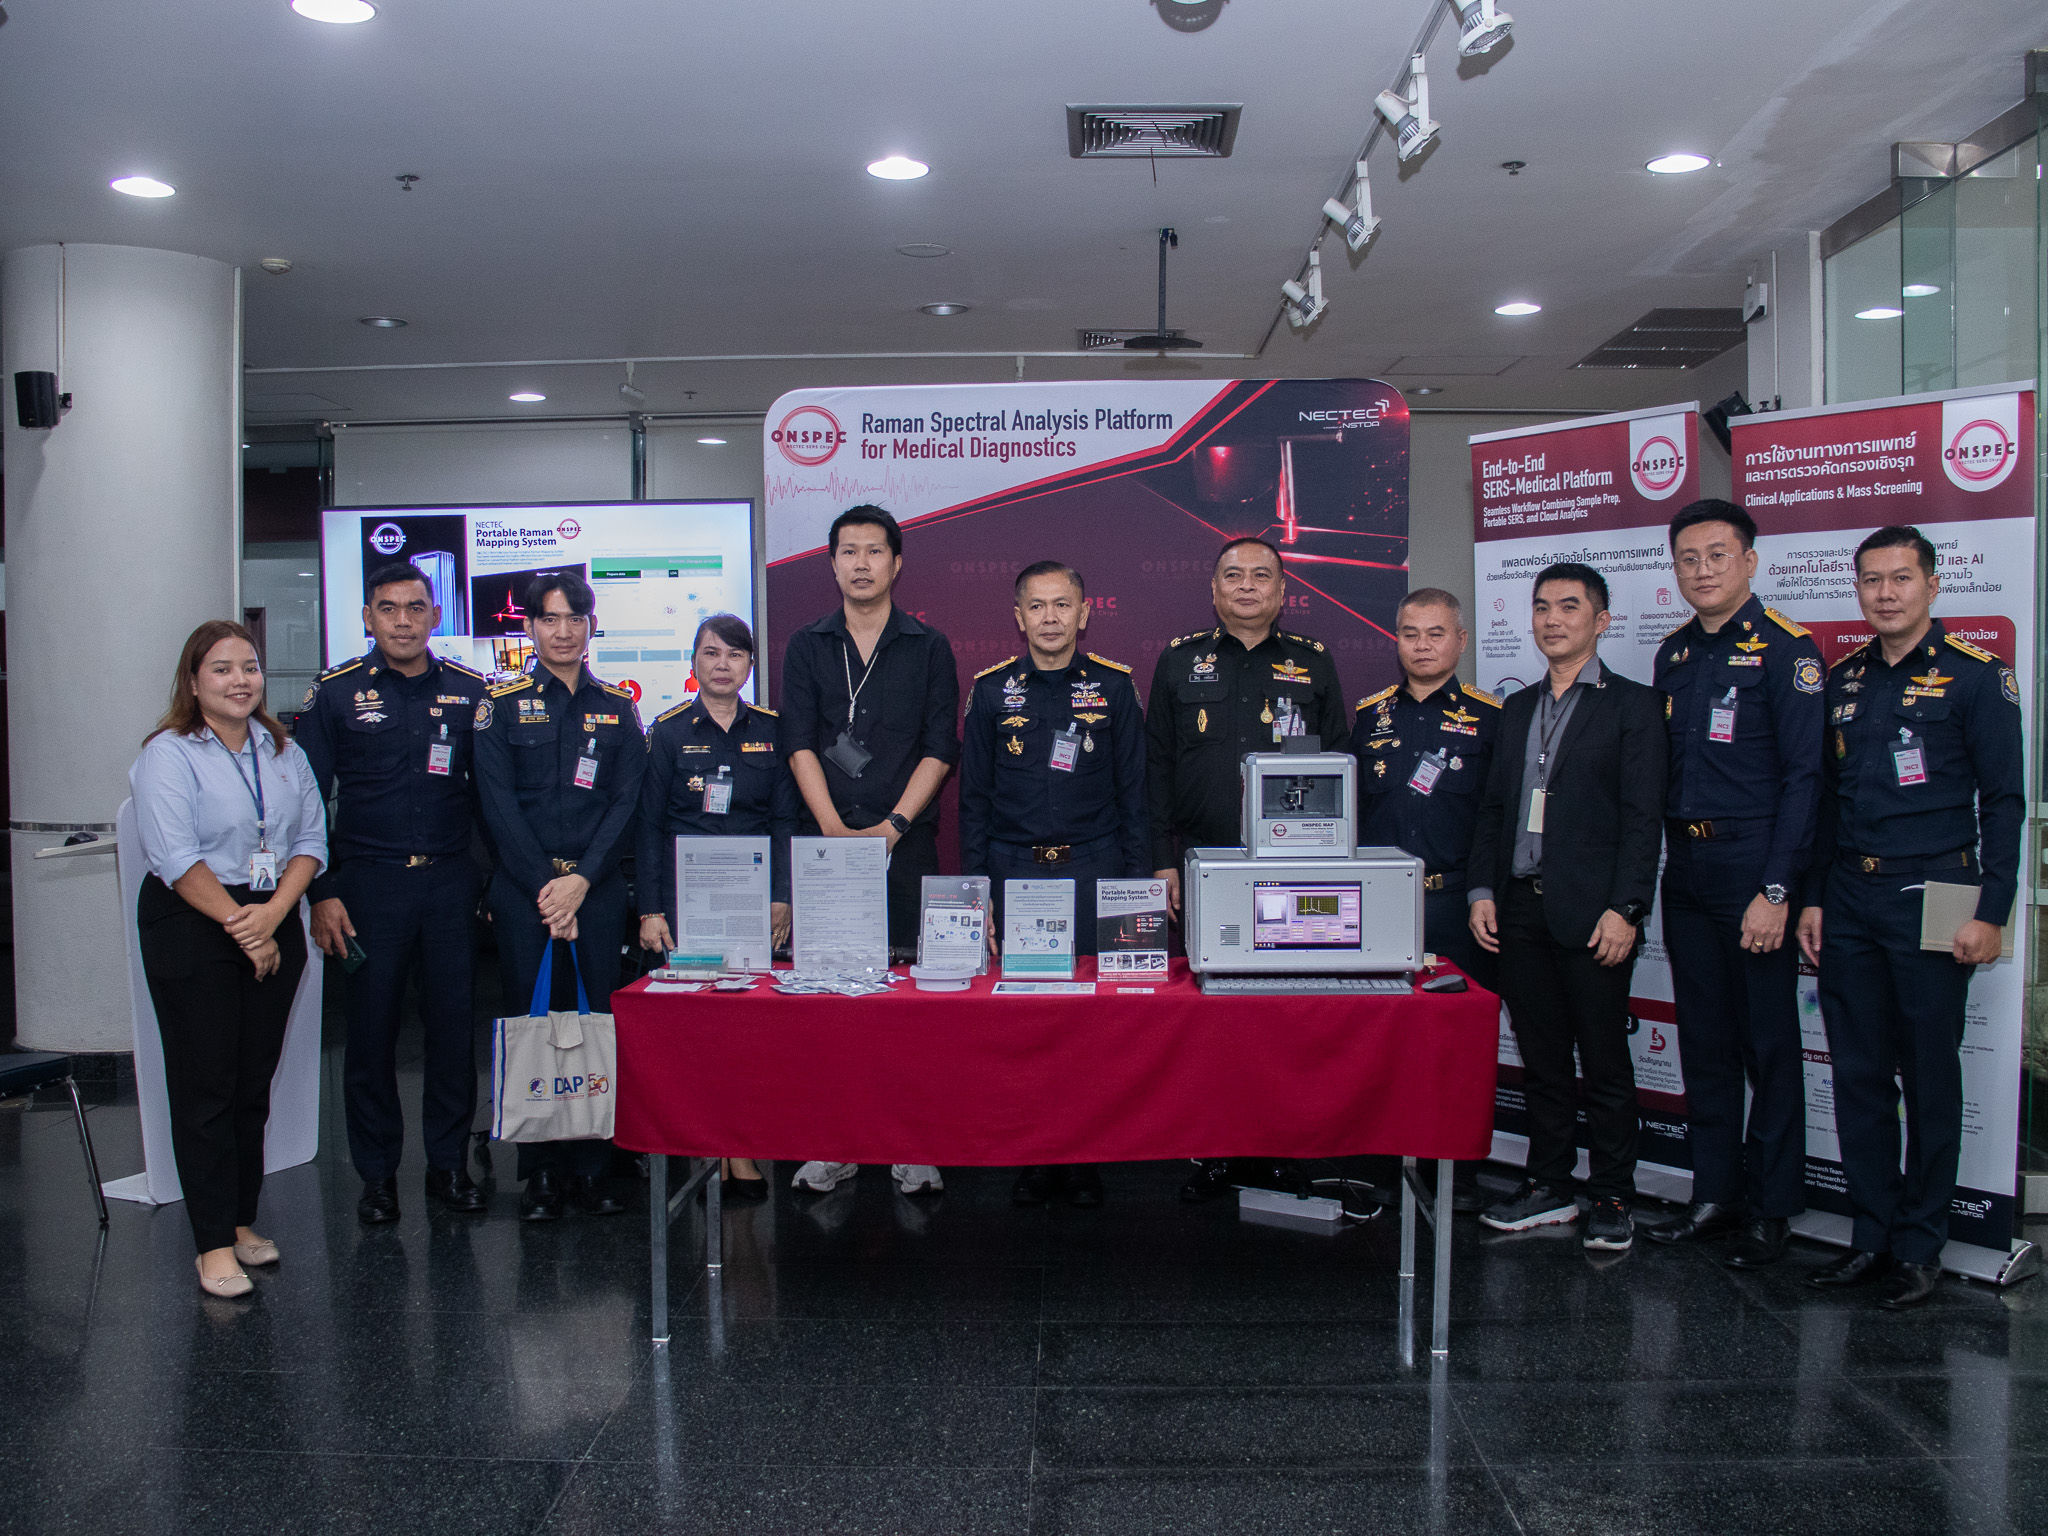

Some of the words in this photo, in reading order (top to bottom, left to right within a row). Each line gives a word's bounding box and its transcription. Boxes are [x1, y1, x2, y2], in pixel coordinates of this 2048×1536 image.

[1299, 408, 1379, 421] NECTEC
[862, 412, 924, 434] Raman
[931, 409, 1007, 437] Spectral
[1012, 408, 1089, 436] Analysis
[1095, 408, 1173, 430] Platform
[1342, 421, 1380, 429] NSTDA
[771, 430, 847, 444] ONSPEC
[861, 438, 887, 459] for
[893, 437, 965, 459] Medical
[970, 435, 1077, 463] Diagnostics
[1745, 430, 1917, 466] การใช้งานทางการแพทย์
[1944, 442, 2016, 461] ONSPEC
[1482, 453, 1545, 479] End-to-End
[1631, 456, 1685, 473] ONSPEC
[1745, 455, 1915, 483] และการตรวจคัดกรองเชิงรุก
[1482, 473, 1561, 499] SERS-Medical
[1562, 469, 1613, 490] Platform
[1745, 491, 1778, 507] Clinical
[1778, 487, 1835, 507] Applications
[1836, 486, 1844, 499] &
[1846, 484, 1872, 498] Mass
[1873, 479, 1923, 495] Screening
[1483, 505, 1511, 517] Seamless
[1511, 501, 1541, 514] Workflow
[1541, 498, 1575, 511] Combining
[1576, 494, 1602, 508] Sample
[1602, 493, 1621, 505] Prep.
[475, 521, 504, 529] NECTEC
[1483, 516, 1507, 528] Portable
[1526, 512, 1539, 523] and
[1539, 510, 1559, 522] Cloud
[1559, 508, 1588, 521] Analytics
[369, 534, 407, 544] ONSPEC
[476, 528, 518, 538] Portable
[519, 529, 554, 537] Raman
[476, 537, 520, 548] Mapping
[522, 537, 557, 547] System
[1948, 555, 1968, 566] และ
[1971, 553, 1984, 564] AI
[1084, 597, 1117, 609] PEC
[1813, 1053, 1823, 1061] on
[554, 1075, 584, 1094] DAP
[1645, 1120, 1685, 1134] NECTEC
[1804, 1162, 1829, 1173] Research
[1829, 1167, 1844, 1176] Team
[1816, 1172, 1841, 1184] Research
[1816, 1180, 1847, 1193] Technology
[1951, 1199, 1984, 1213] CTEC
